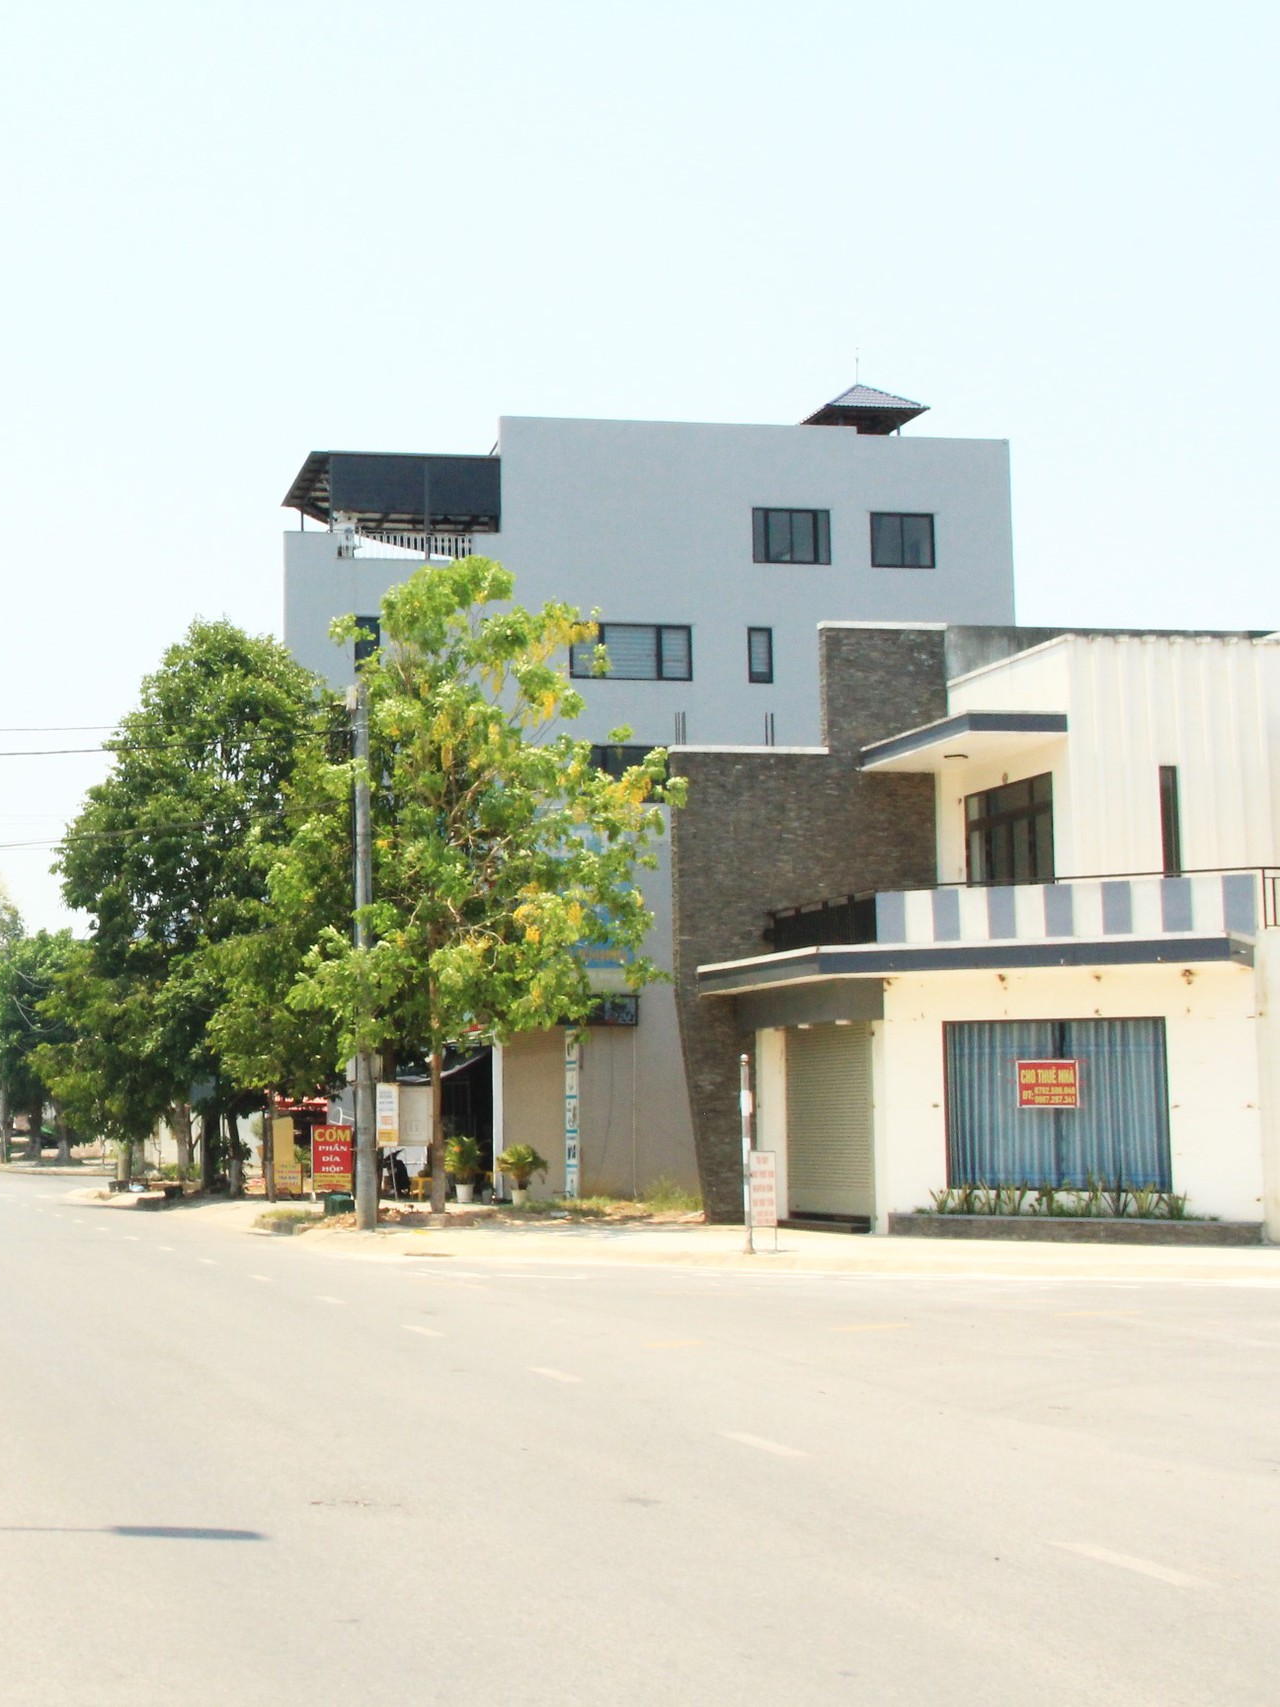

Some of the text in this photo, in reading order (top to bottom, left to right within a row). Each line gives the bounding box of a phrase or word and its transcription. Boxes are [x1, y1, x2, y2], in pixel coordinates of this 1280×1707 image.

[1020, 1069, 1036, 1084] CHO
[1037, 1066, 1057, 1084] THUÊ
[313, 1126, 352, 1142] CƠM
